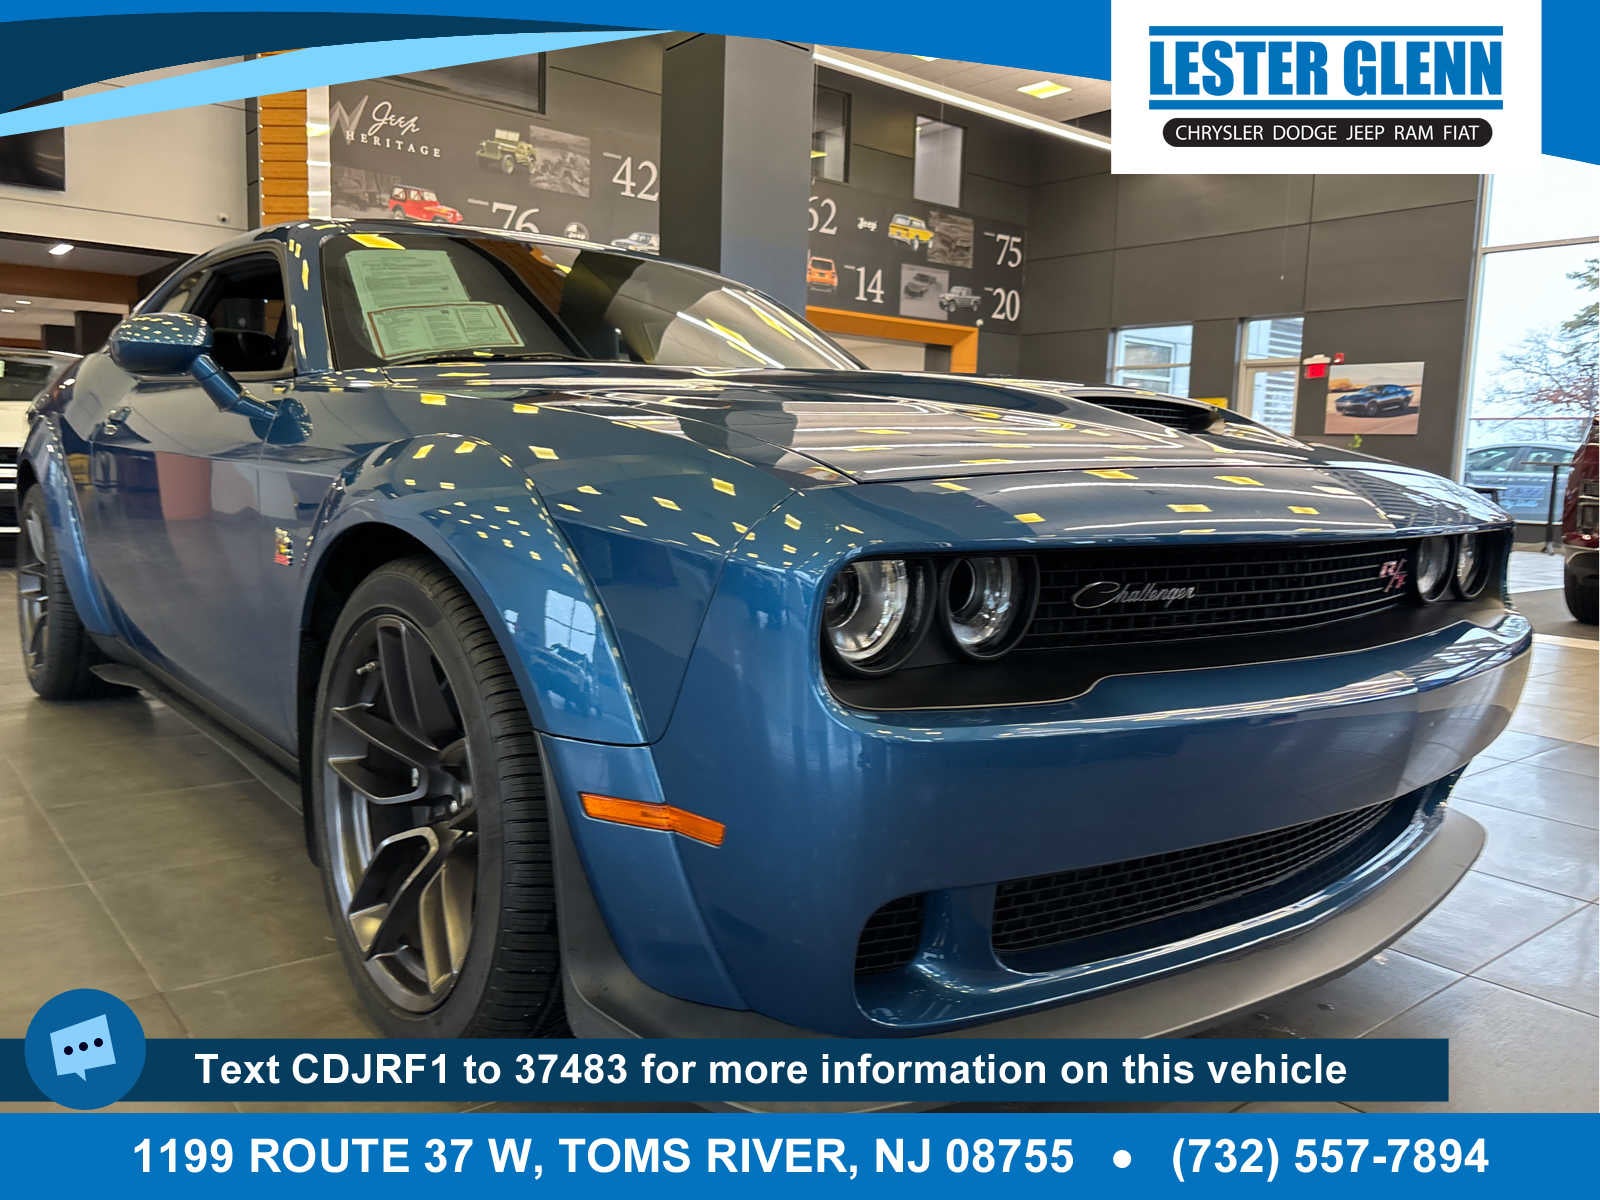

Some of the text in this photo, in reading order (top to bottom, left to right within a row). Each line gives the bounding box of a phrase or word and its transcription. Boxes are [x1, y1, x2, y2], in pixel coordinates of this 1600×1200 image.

[367, 101, 420, 137] Jeep
[345, 131, 441, 158] HERITAGE
[1072, 581, 1196, 609] Challenger
